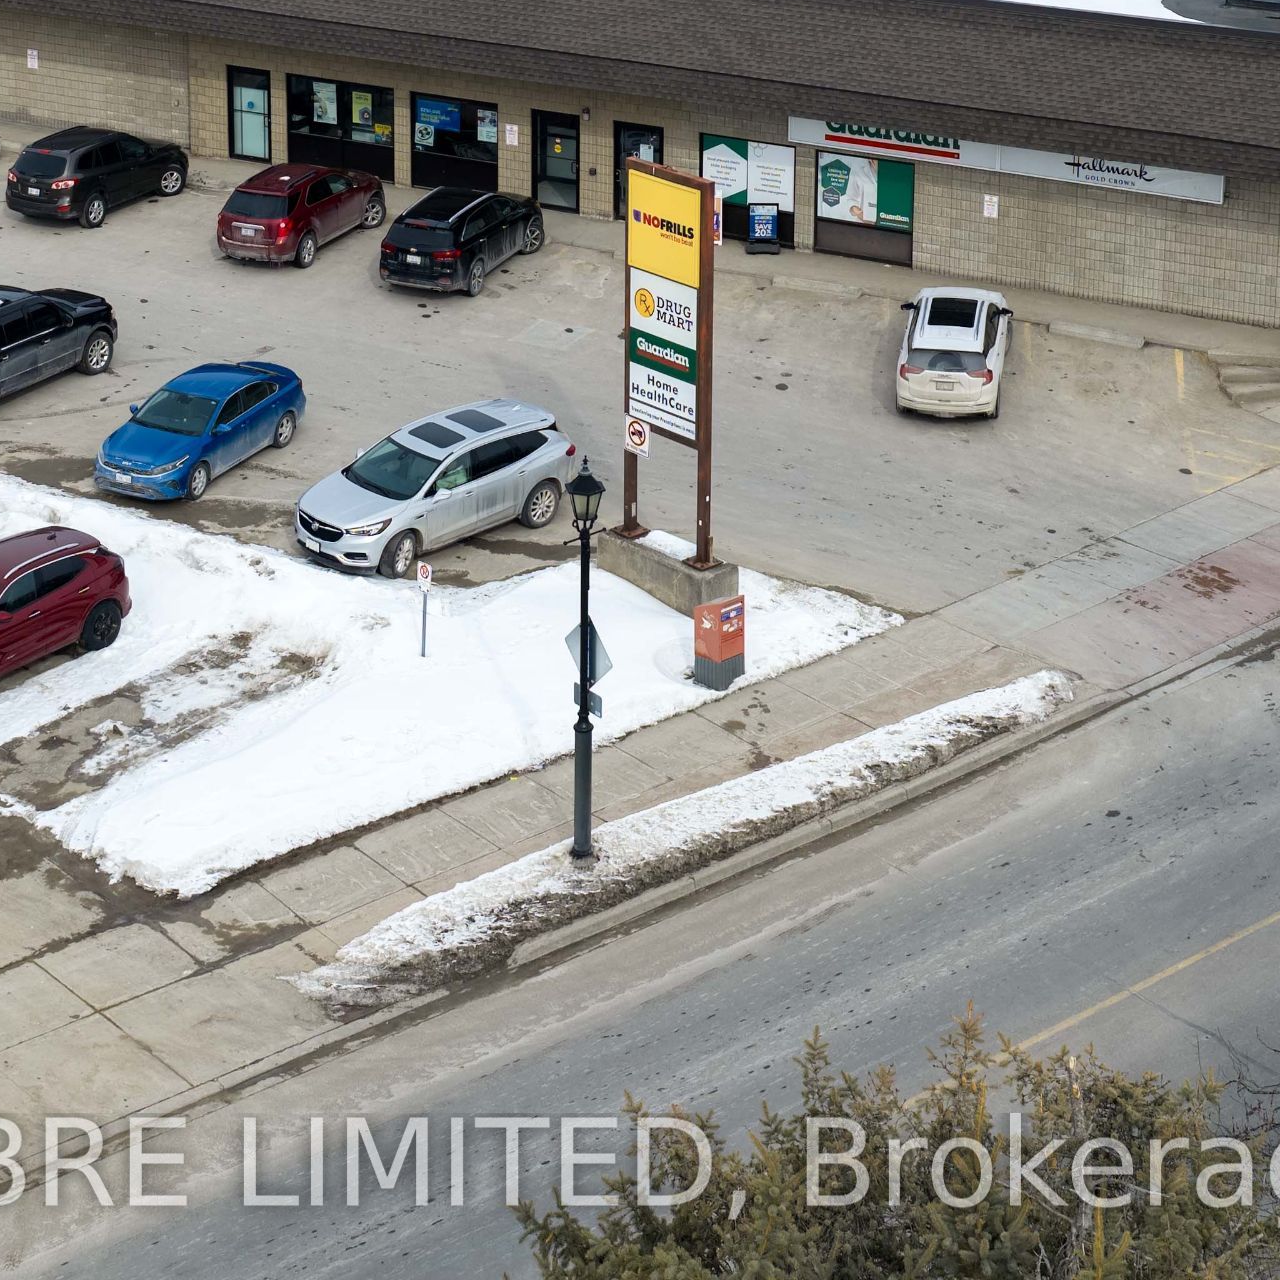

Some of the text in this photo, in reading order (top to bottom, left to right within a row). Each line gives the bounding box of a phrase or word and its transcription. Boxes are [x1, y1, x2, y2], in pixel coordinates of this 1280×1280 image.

[1064, 153, 1156, 182] Hallmark
[1085, 174, 1136, 187] GOLD CROWN
[656, 296, 692, 319] DRUG
[656, 309, 694, 332] MART
[636, 337, 690, 368] Guardian
[647, 373, 679, 396] Home
[631, 382, 694, 416] HealthCare
